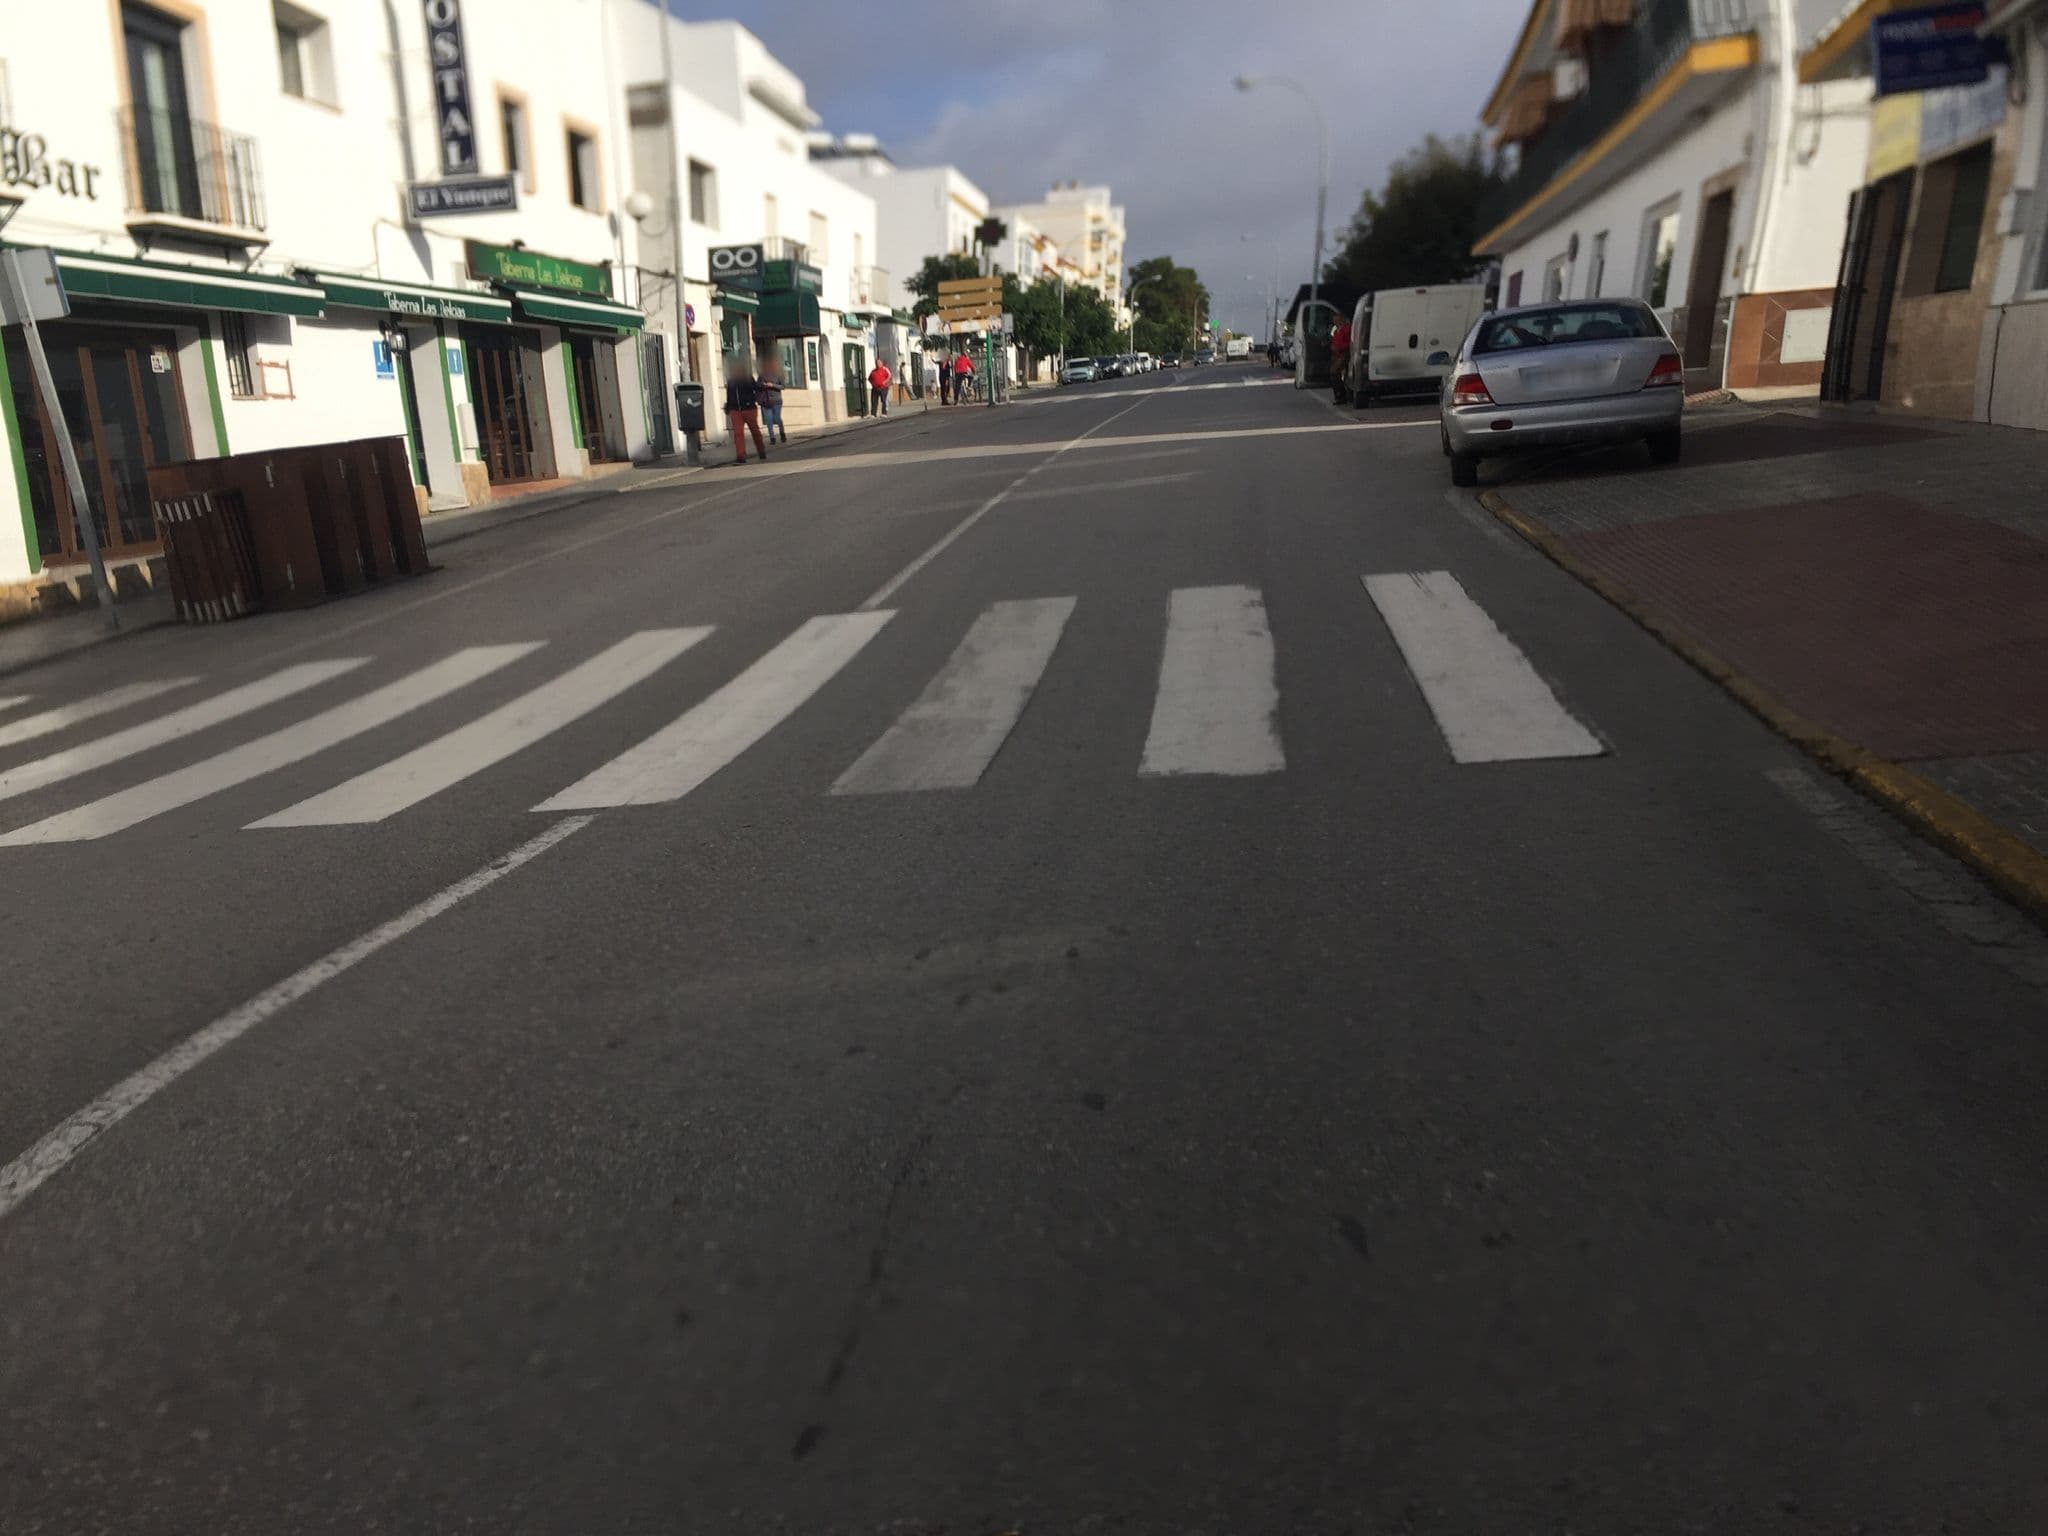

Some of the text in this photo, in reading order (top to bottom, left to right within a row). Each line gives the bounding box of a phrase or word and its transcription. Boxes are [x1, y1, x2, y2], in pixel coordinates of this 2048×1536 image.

[0, 128, 101, 201] Bar
[495, 251, 536, 281] Taberna
[536, 258, 553, 283] Las
[383, 289, 420, 313] Taberna
[421, 295, 437, 315] Las
